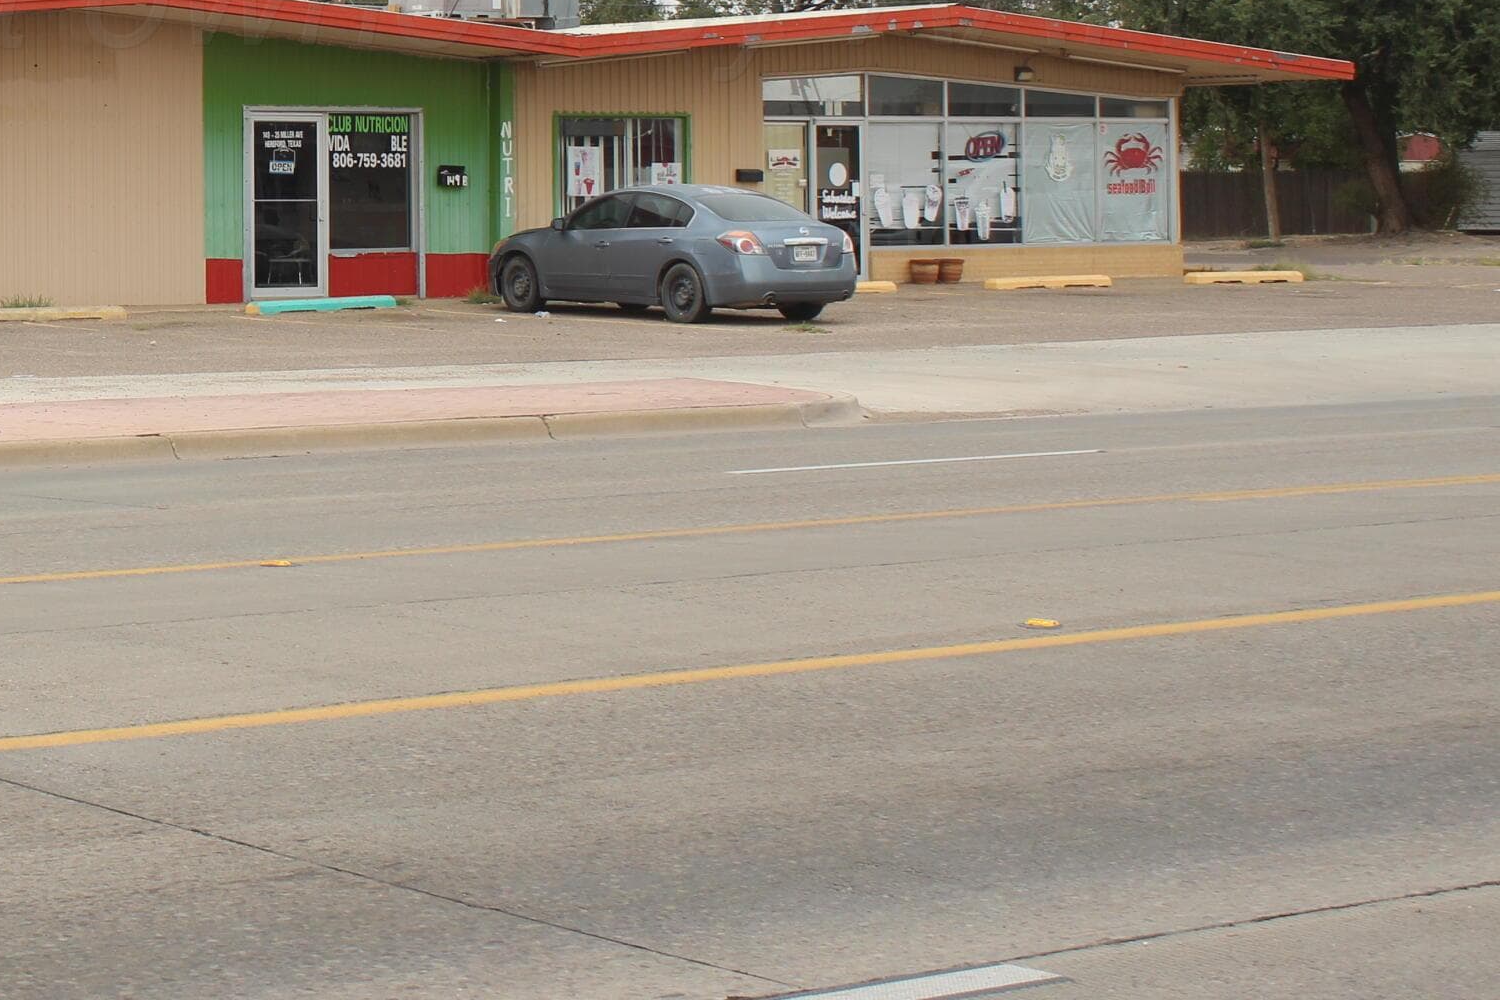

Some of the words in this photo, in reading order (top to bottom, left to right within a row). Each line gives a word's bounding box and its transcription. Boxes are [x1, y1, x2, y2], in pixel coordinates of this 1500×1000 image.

[329, 116, 352, 133] CLUB
[355, 116, 408, 133] NUTRICION
[328, 135, 351, 152] VIDA
[390, 135, 408, 152] BLE
[967, 136, 1002, 158] OPEN
[271, 163, 293, 172] OPEN
[332, 153, 406, 168] 806-759-3681
[446, 175, 460, 186] 149
[822, 205, 857, 220] Welcome
